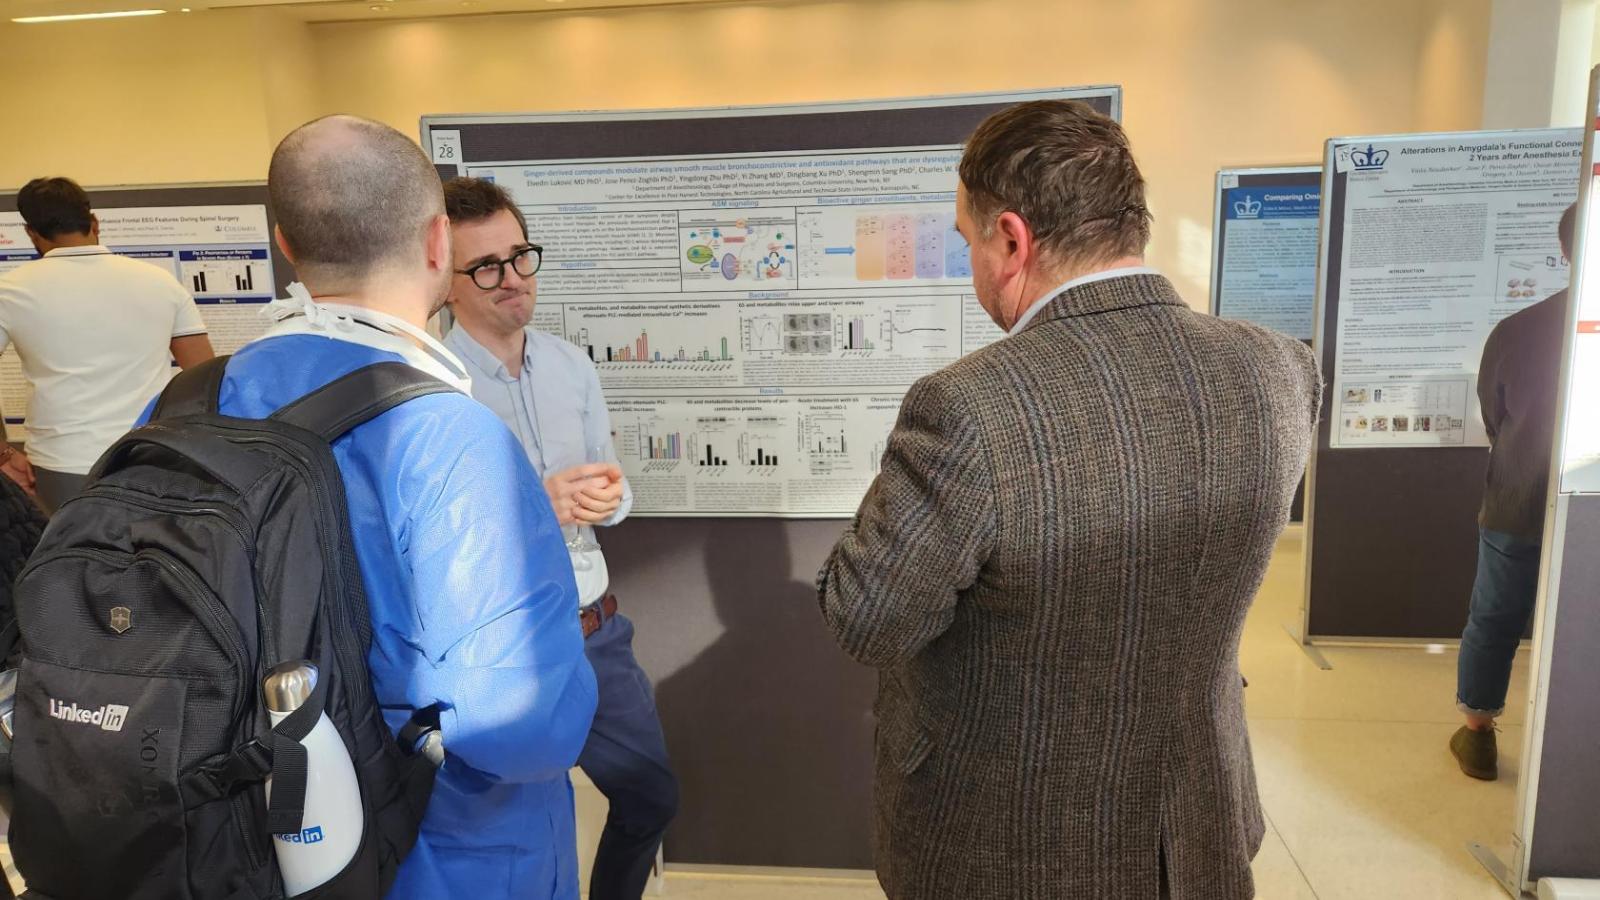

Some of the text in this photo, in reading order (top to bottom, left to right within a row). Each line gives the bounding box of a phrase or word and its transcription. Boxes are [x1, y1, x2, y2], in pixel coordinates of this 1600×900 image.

[439, 146, 455, 159] 28
[1400, 146, 1446, 155] Alterations
[1457, 143, 1507, 153] Amygdala's
[1508, 141, 1553, 150] Functional
[1476, 153, 1500, 161] Years
[1501, 152, 1521, 160] after
[1522, 150, 1570, 159] Anesthesia
[524, 168, 573, 177] Ginger-derived
[574, 168, 614, 177] compounds
[615, 167, 649, 175] modulate
[650, 166, 672, 174] airway
[674, 164, 700, 172] smooth
[702, 163, 725, 171] muscle
[727, 161, 797, 170] bronchoconstrictive
[798, 160, 812, 168] and
[814, 159, 854, 168] antioxidant
[855, 158, 890, 167] pathways
[574, 178, 585, 186] MD
[604, 177, 618, 185] Jose
[679, 174, 708, 183] Yingdong
[709, 174, 722, 182] Zhu
[749, 173, 768, 181] Zhang
[787, 171, 817, 179] Dingbang
[848, 168, 881, 176] Shengmin
[882, 167, 898, 175] Sang
[918, 165, 943, 173] Charles
[635, 184, 666, 192] Department
[817, 197, 850, 205] Bioactive
[850, 196, 872, 204] ginger
[1264, 193, 1304, 202] Comparing
[728, 199, 759, 207] signaling
[558, 204, 597, 212] Introduction
[180, 215, 198, 224] During
[199, 215, 216, 223] Spinal
[217, 214, 239, 224] Surgery
[560, 261, 597, 269] Hypothesis
[748, 291, 788, 299] Background
[759, 387, 784, 395] Results
